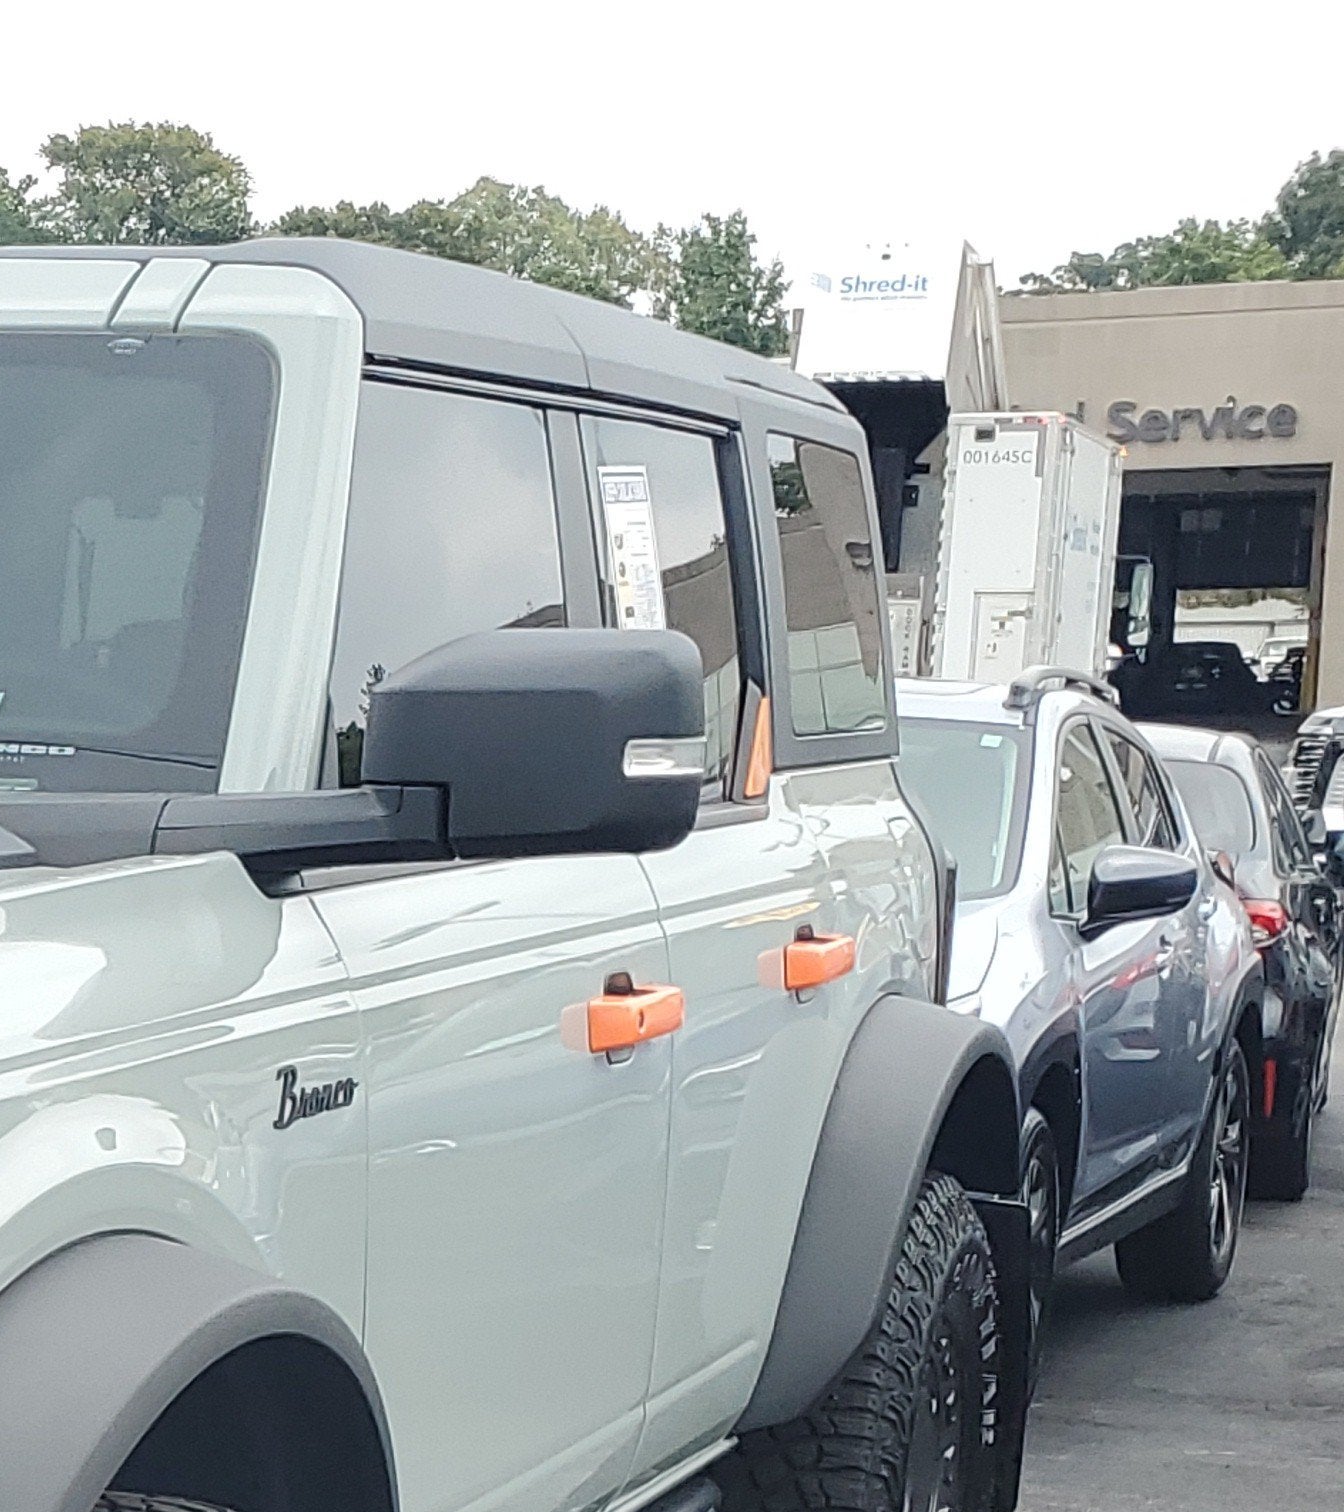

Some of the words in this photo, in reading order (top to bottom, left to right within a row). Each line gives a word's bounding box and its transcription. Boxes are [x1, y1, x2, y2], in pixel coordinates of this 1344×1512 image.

[839, 274, 929, 294] Shred-it
[1106, 394, 1298, 443] Service
[962, 449, 1034, 464] 001645C
[272, 1064, 359, 1130] Bronco
